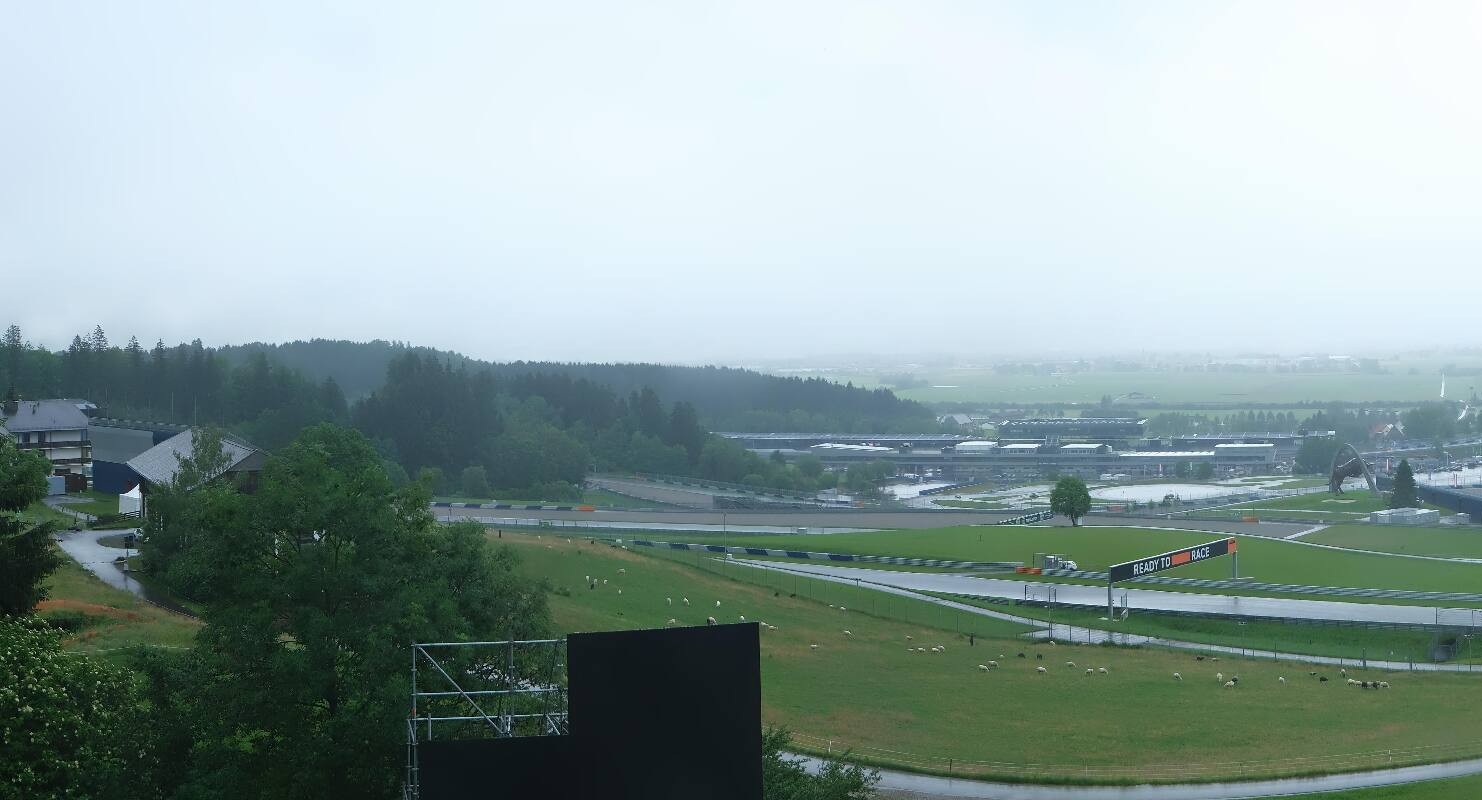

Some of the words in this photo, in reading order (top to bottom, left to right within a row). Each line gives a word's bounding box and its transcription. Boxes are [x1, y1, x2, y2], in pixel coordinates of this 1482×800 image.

[1133, 559, 1160, 576] READY
[1161, 557, 1171, 569] TO
[1191, 547, 1210, 561] RACE
